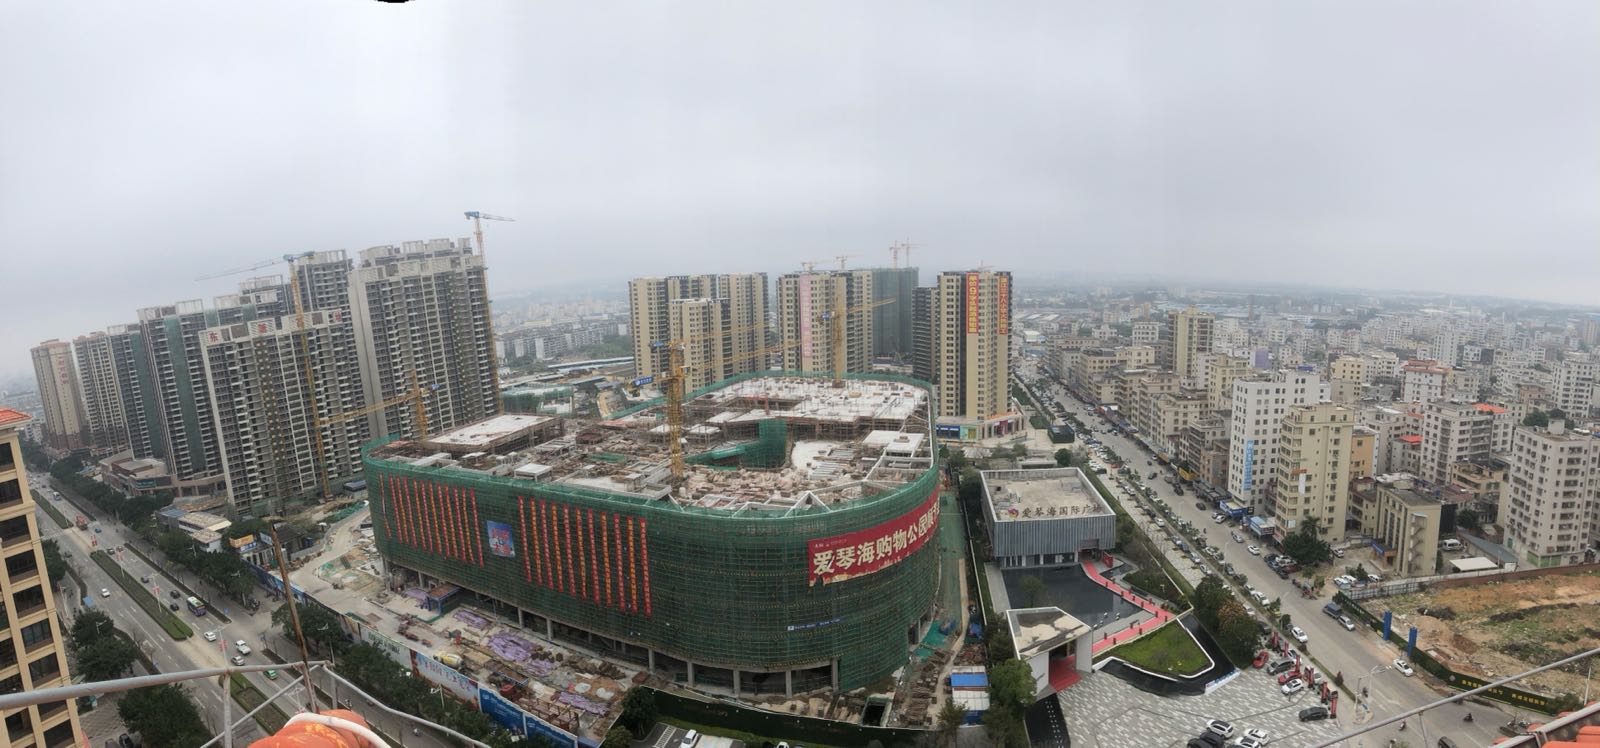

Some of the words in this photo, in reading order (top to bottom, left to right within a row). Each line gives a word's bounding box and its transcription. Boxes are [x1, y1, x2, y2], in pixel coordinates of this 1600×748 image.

[1021, 503, 1105, 519] 爱琴海国际广场
